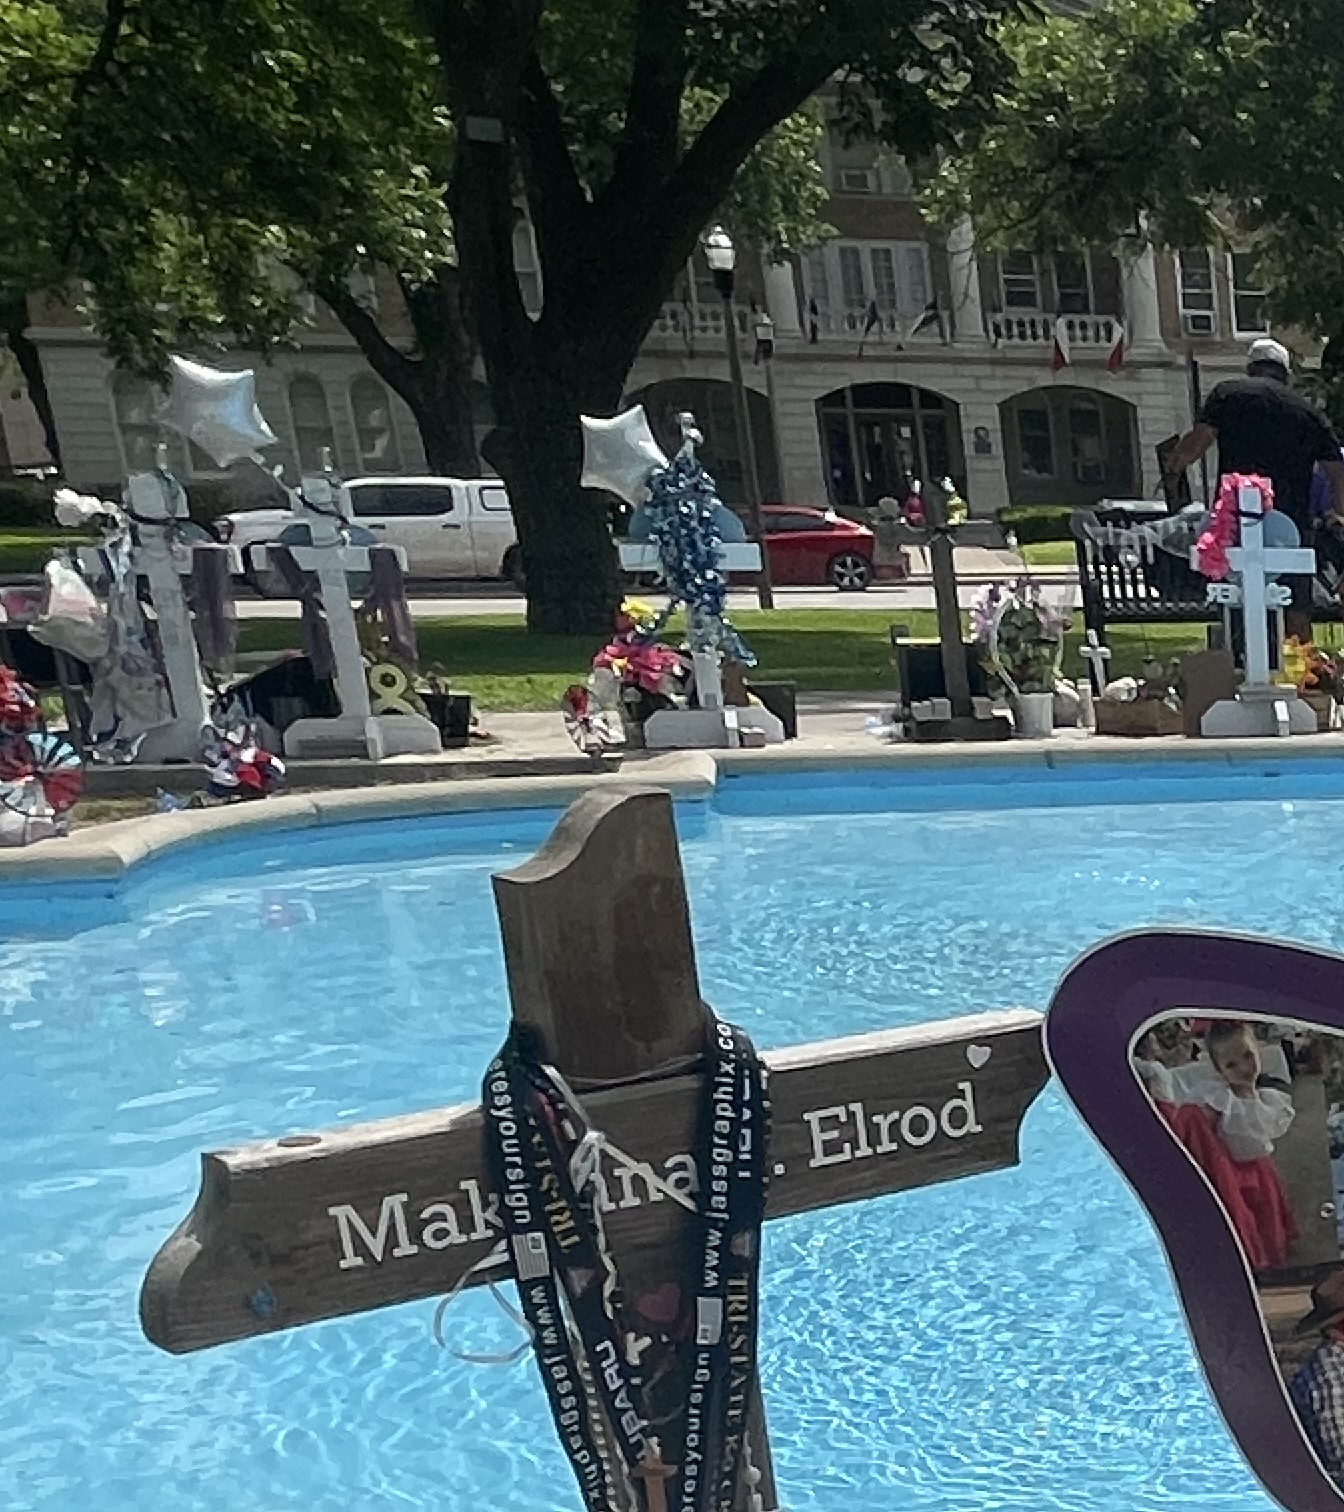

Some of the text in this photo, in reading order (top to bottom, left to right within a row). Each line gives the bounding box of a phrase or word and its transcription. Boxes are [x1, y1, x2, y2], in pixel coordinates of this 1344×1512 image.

[329, 1144, 701, 1272] Maknna
[803, 1081, 984, 1169] Elrod
[595, 1340, 649, 1461] UBARU
